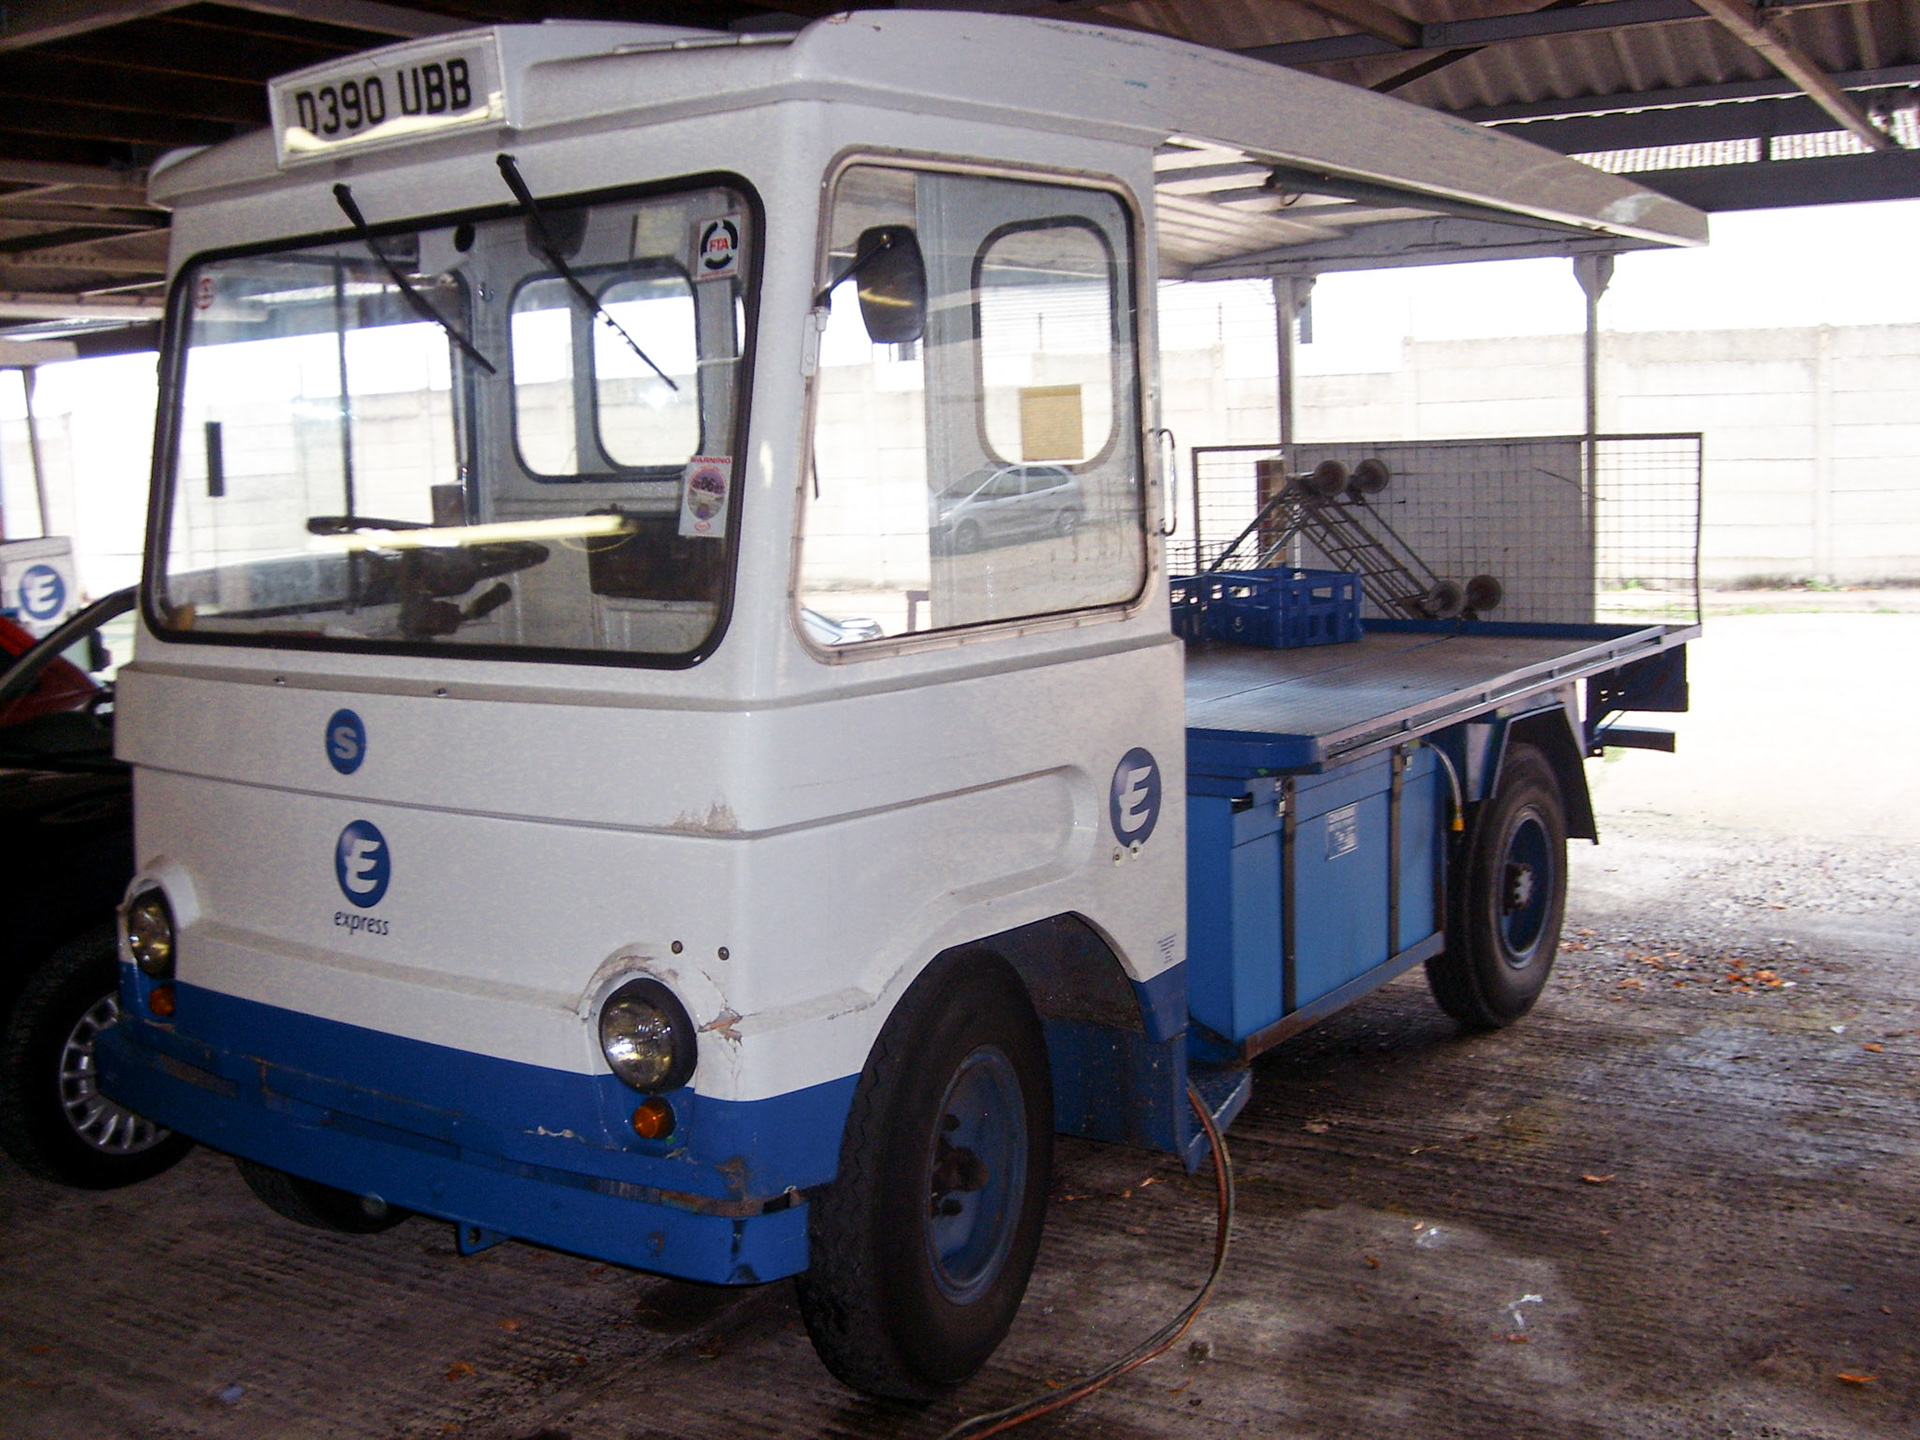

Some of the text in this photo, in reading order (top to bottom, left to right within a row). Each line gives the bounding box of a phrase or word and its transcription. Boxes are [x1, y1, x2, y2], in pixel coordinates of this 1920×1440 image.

[295, 57, 472, 135] D390 UBB
[709, 237, 730, 252] FTA
[690, 455, 732, 464] WARNING
[332, 726, 359, 760] S
[334, 911, 389, 936] express
